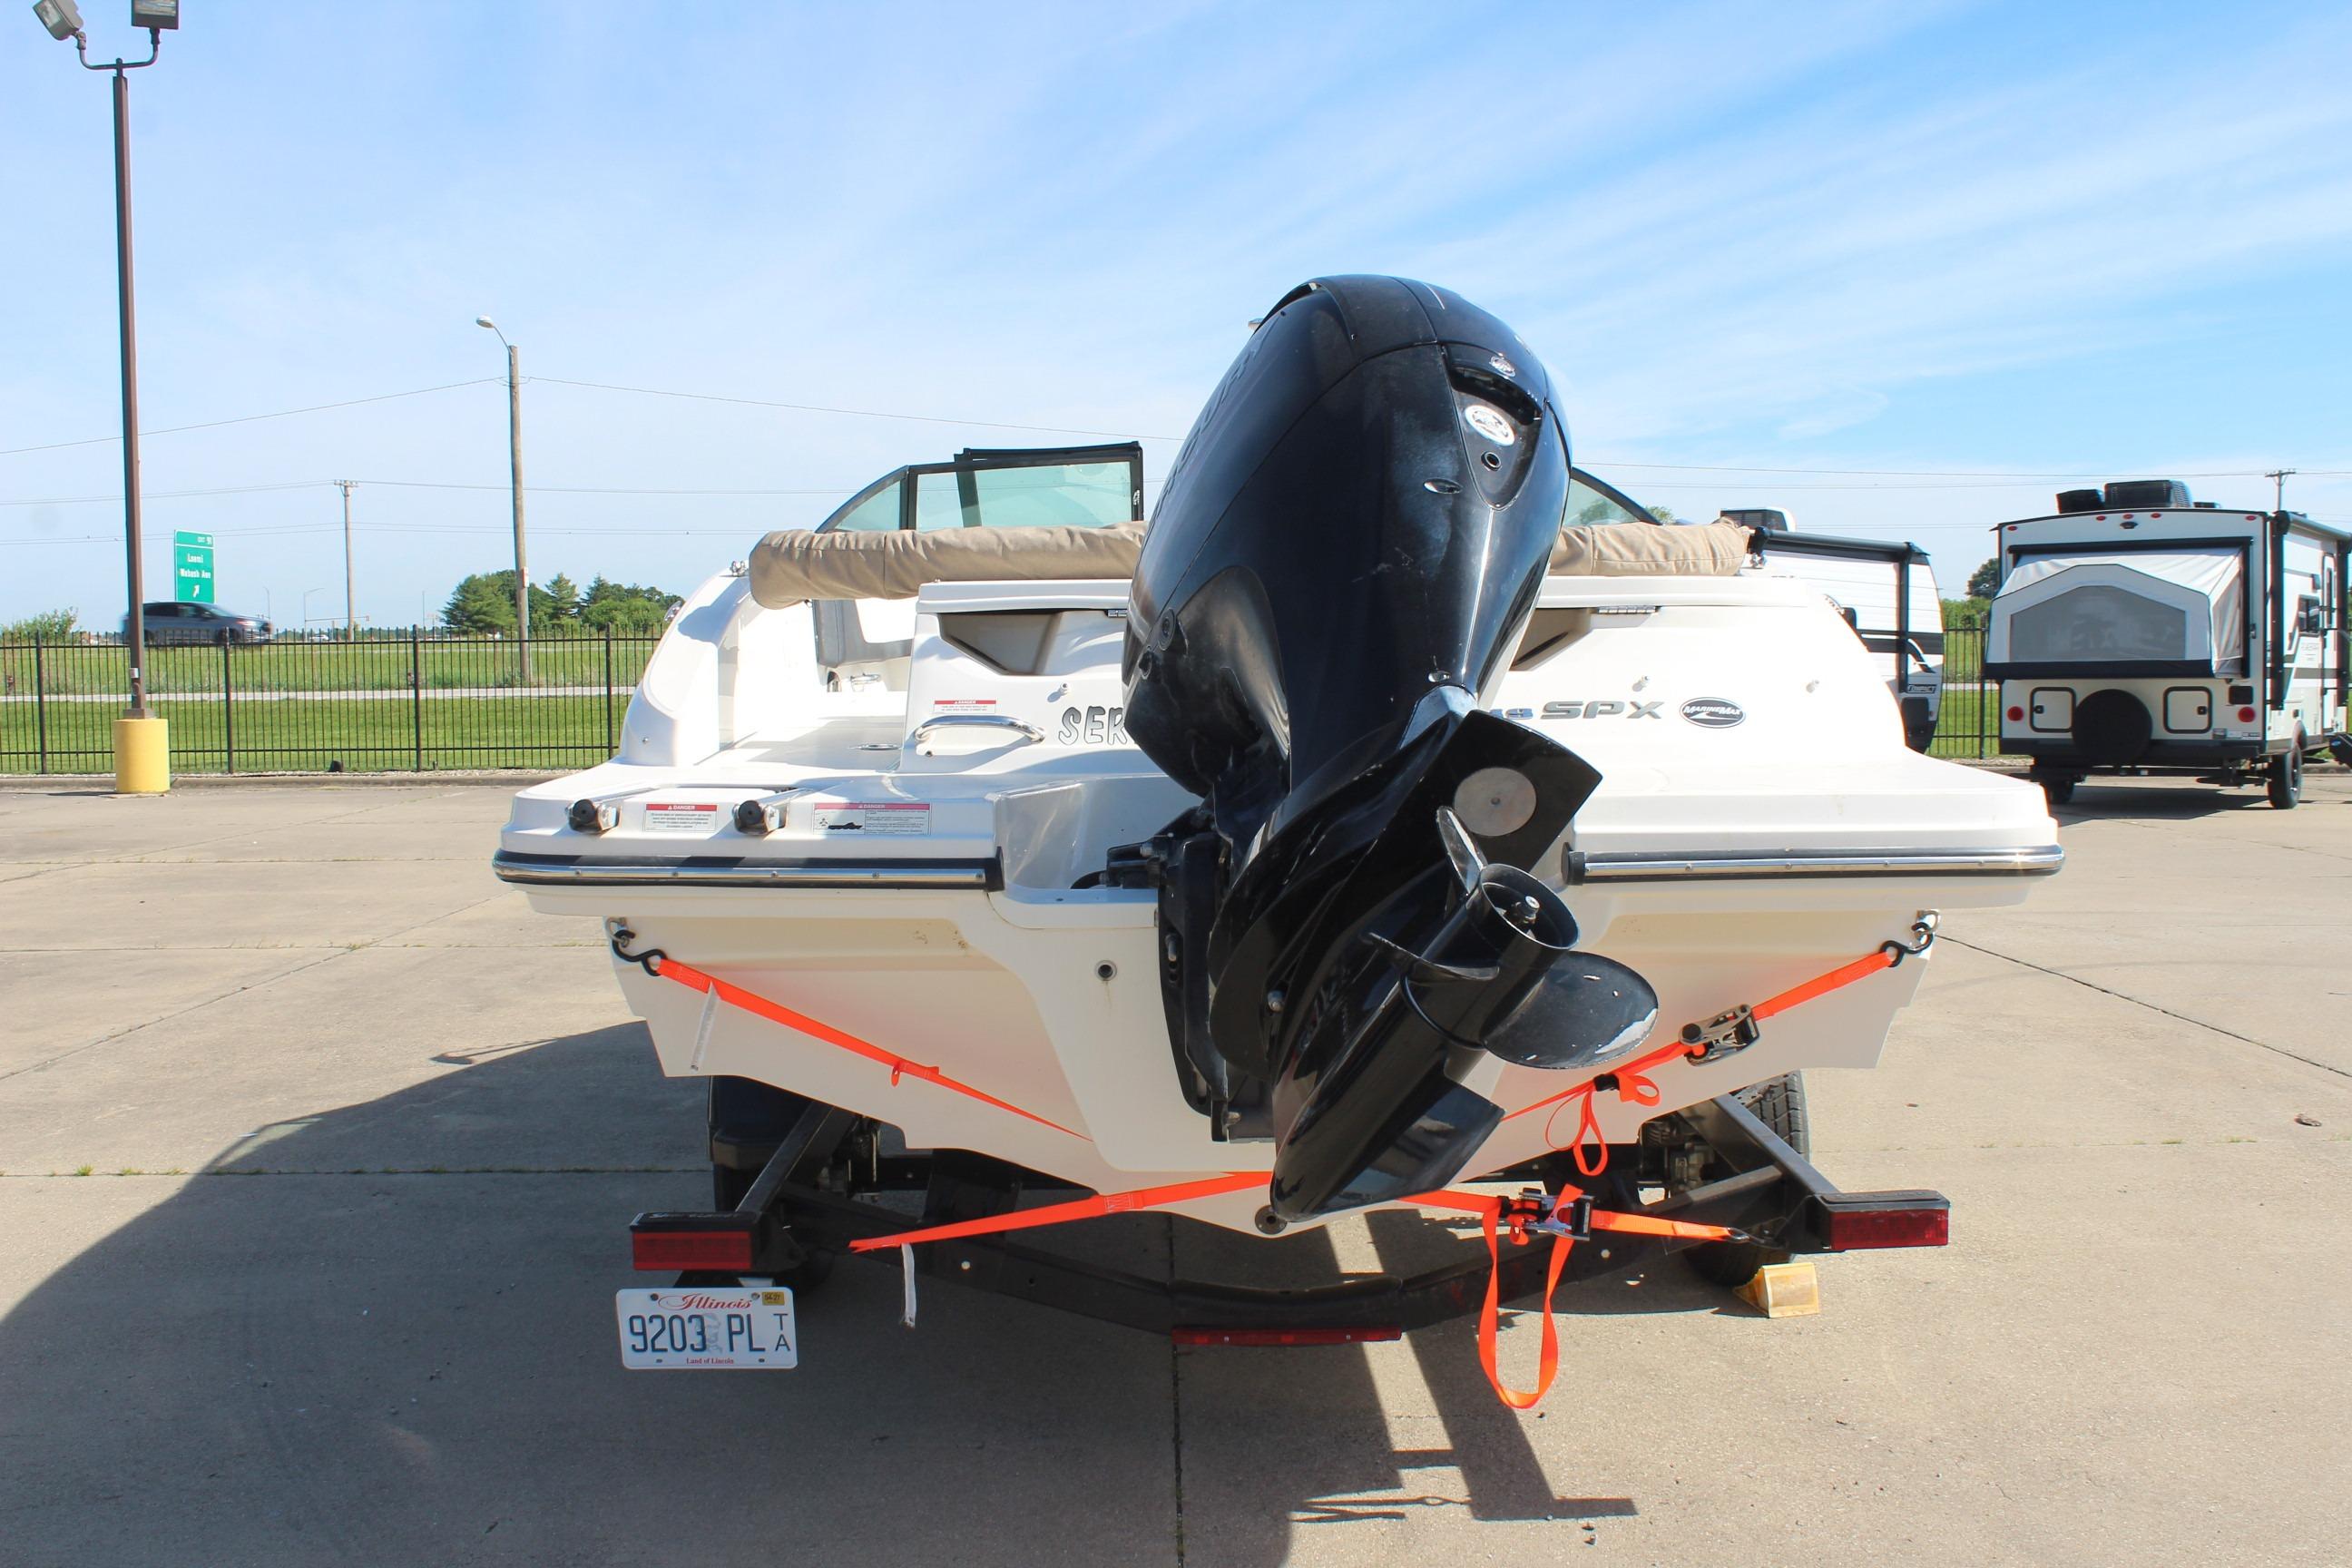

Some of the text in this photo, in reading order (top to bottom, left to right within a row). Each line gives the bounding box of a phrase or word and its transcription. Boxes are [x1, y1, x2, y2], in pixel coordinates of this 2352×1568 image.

[1540, 701, 1664, 720] SPX
[658, 1293, 752, 1310] Illinois
[629, 1313, 766, 1352] 9203 PL
